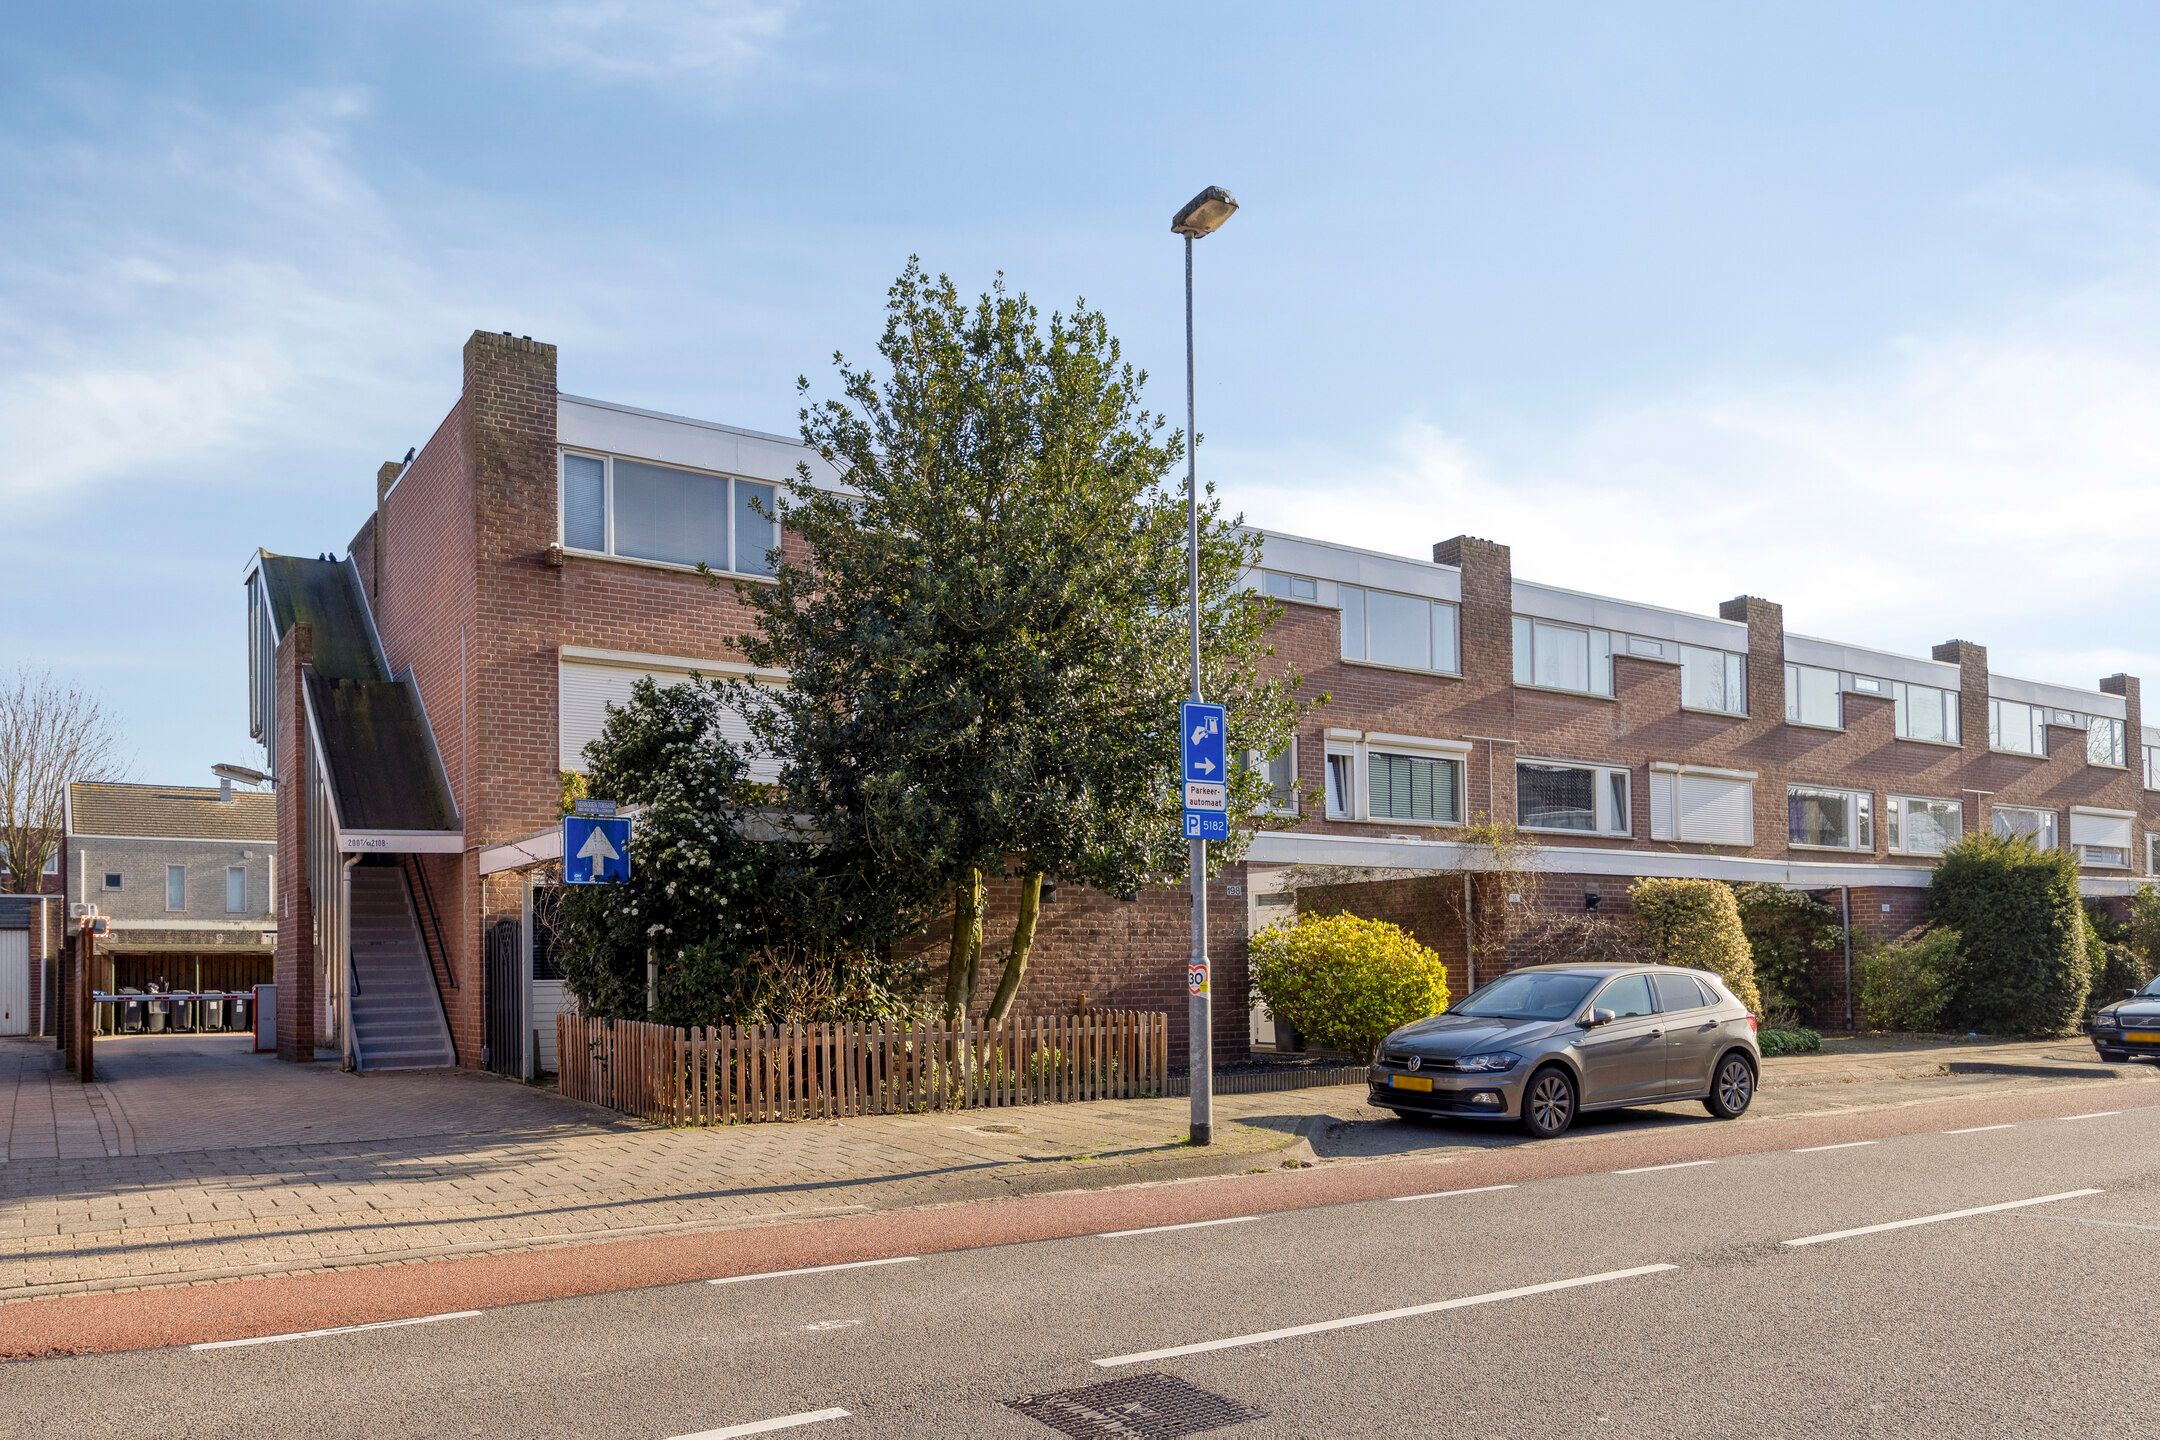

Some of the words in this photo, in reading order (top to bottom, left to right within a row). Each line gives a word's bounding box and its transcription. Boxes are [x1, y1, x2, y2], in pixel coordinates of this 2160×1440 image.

[1190, 785, 1220, 796] Parkeer-
[1189, 798, 1222, 807] automaat
[1188, 816, 1199, 834] P
[1203, 820, 1224, 831] 5182
[1226, 886, 1240, 895] 198
[1189, 972, 1203, 985] 30
